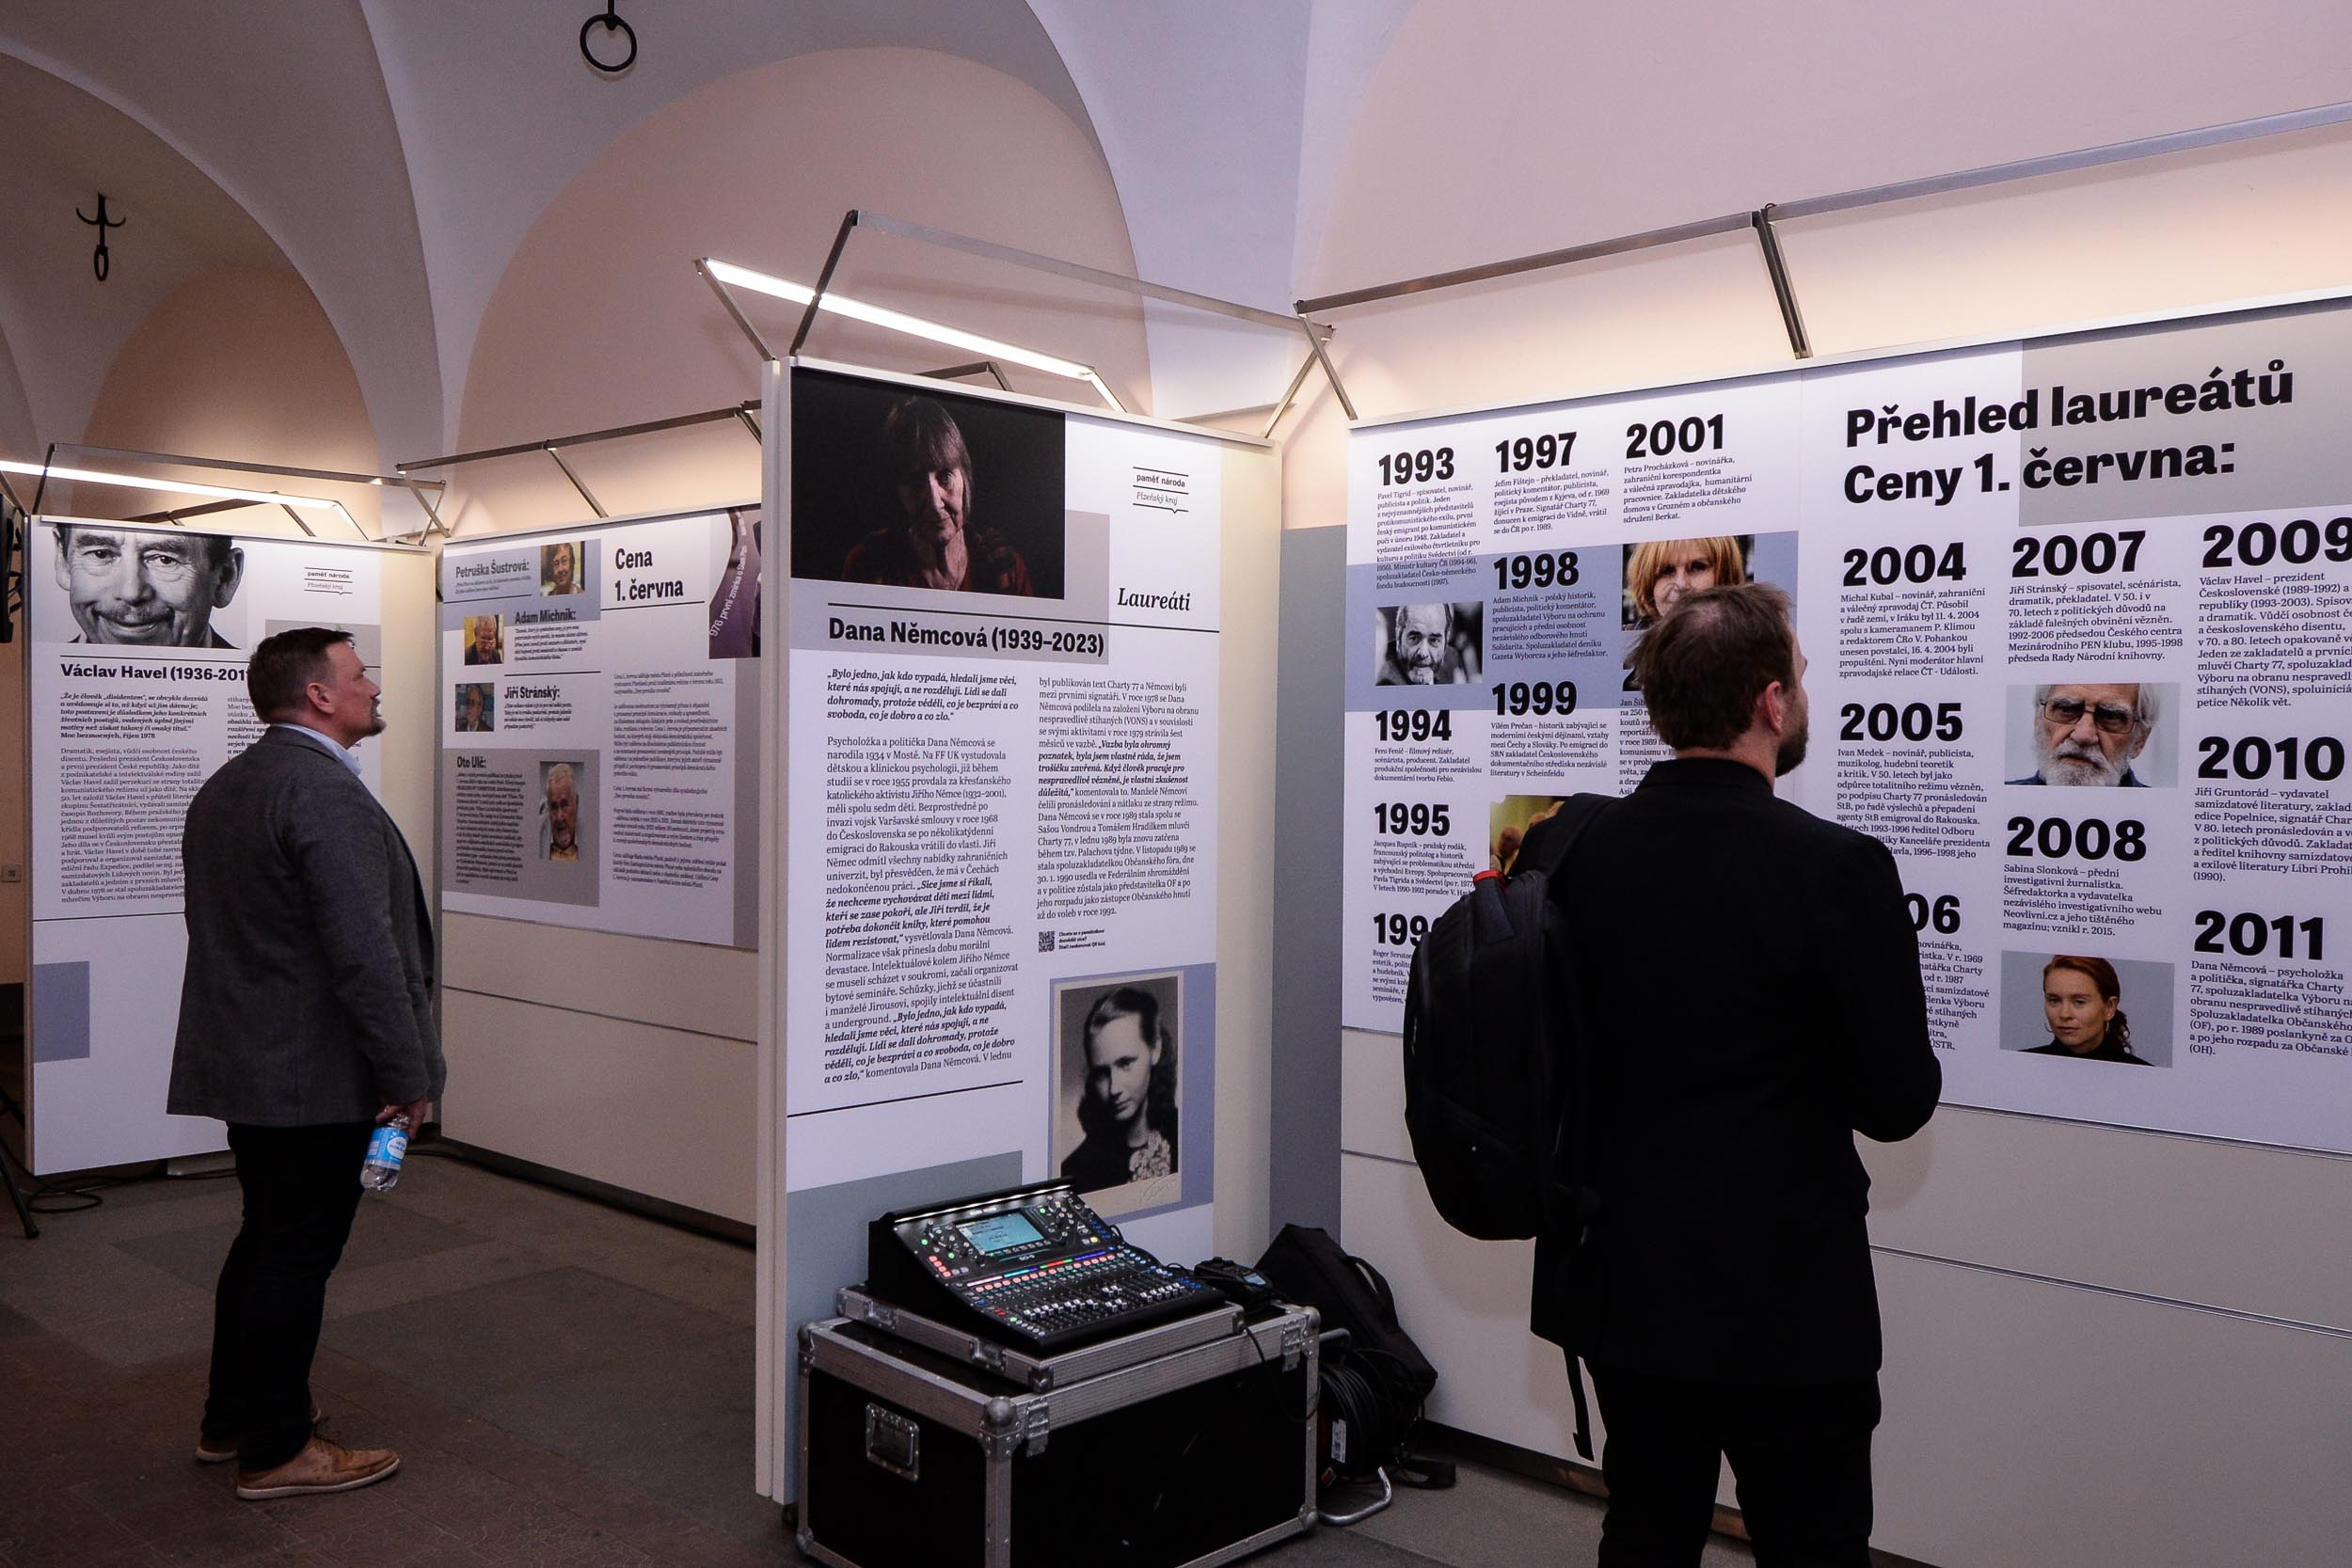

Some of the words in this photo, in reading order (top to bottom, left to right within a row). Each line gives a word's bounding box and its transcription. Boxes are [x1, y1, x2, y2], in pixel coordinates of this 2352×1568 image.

[1847, 388, 2039, 448] Přehled
[2051, 359, 2294, 427] laureátů
[1627, 414, 1723, 459] 2001
[1496, 432, 1576, 472] 1997
[1379, 448, 1454, 485] 1993
[1624, 473, 1661, 484] zahraniční
[1662, 467, 1722, 480] korespondentka
[1844, 465, 1963, 505] Ceny
[1974, 452, 2010, 493] 1.
[2023, 442, 2235, 489] června:
[1136, 474, 1159, 483] paměť
[1161, 476, 1185, 487] národa
[1136, 491, 1164, 504] Plzeňský
[1165, 496, 1178, 506] kraj
[1624, 494, 1663, 505] pracovnice.
[1664, 489, 1711, 499] Zakladatelka
[1712, 485, 1746, 496] dětského
[2202, 517, 2352, 567] 2009
[615, 548, 653, 570] Cena
[2012, 531, 2145, 578] 2007
[455, 563, 489, 578] Petruška
[490, 559, 530, 575] Šustrová:
[1494, 552, 1579, 590] 1998
[1843, 543, 1966, 586] 2004
[615, 580, 626, 601] 1.
[629, 580, 684, 600] června
[1118, 587, 1191, 611] Laureáti
[2199, 586, 2280, 598] Československé
[2282, 583, 2341, 595] (1989-1992)
[515, 611, 538, 625] Adam
[539, 608, 576, 623] Michnik:
[2009, 619, 2043, 628] základě
[2045, 617, 2089, 628] falešných
[2090, 615, 2133, 626] obvinění
[2135, 615, 2172, 625] vězněn.
[829, 618, 885, 642] Dana
[891, 621, 988, 647] Němcová
[2056, 628, 2106, 641] předsedou
[2107, 626, 2149, 637] Českého
[2150, 627, 2182, 636] centra
[2206, 623, 2299, 634] československého
[2301, 622, 2345, 631] disentu,
[2009, 641, 2079, 651] Mezinárodního
[2081, 641, 2101, 649] PEN
[2103, 640, 2134, 649] klubu,
[1839, 657, 1886, 669] propuštění.
[1888, 657, 1908, 667] Nyní
[1910, 656, 1955, 665] moderátor
[1956, 655, 1983, 664] hlavní
[2008, 653, 2050, 664] předseda
[2052, 653, 2075, 663] Rady
[2076, 651, 2116, 661] Národní
[2118, 651, 2165, 661] knihovny.
[60, 663, 117, 677] Václav
[121, 665, 167, 679] Havel
[170, 665, 249, 683] (1936-201
[852, 668, 879, 681] jedno,
[880, 670, 895, 681] jak
[897, 671, 913, 681] kdo
[914, 673, 948, 683] vypadá,
[949, 672, 978, 683] hledali
[977, 673, 997, 685] jsme
[999, 675, 1016, 686] věci,
[504, 686, 518, 699] Jiří
[519, 685, 560, 701] Stránský:
[1492, 681, 1577, 715] 1999
[2197, 698, 2228, 708] petice
[2230, 697, 2270, 706] Několik
[2272, 697, 2291, 706] vět.
[1375, 709, 1452, 741] 1994
[1840, 703, 1963, 741] 2005
[827, 736, 881, 748] Psycholožka
[889, 736, 926, 749] politička
[927, 737, 948, 747] Dana
[950, 737, 986, 747] Němcová
[457, 756, 470, 768] Oto
[471, 756, 486, 768] Ulč:
[1837, 759, 1883, 769] muzikolog,
[1883, 759, 1918, 768] hudební
[1920, 760, 1954, 768] teoretik
[2199, 736, 2344, 781] 2010
[1837, 780, 1871, 790] odpůrce
[1872, 781, 1916, 789] totalitního
[1918, 782, 1948, 790] režimu
[1949, 783, 1984, 792] vězněn,
[1375, 803, 1450, 836] 1995
[2007, 816, 2146, 862] 2008
[2004, 876, 2065, 887] investigativní
[2066, 879, 2123, 890] žurnalistka.
[2193, 871, 2226, 882] (1990).
[2003, 887, 2069, 898] Šéfredaktorka
[2077, 891, 2133, 902] vydavatelka
[1037, 911, 1045, 920] až
[1046, 910, 1057, 919] do
[1057, 909, 1076, 918] voleb
[1083, 909, 1099, 917] roce
[1100, 908, 1117, 917] 1992.
[1904, 892, 1962, 935] 06
[2003, 898, 2057, 909] nezávislého
[2058, 901, 2134, 913] investigativního
[2136, 906, 2162, 915] webu
[1372, 912, 1443, 946] 199
[2003, 922, 2050, 932] magazínu;
[2051, 925, 2080, 933] vznikl
[2090, 927, 2116, 936] 2015.
[2195, 911, 2323, 960] 2011
[826, 950, 881, 962] Normalizace
[882, 946, 900, 958] však
[902, 944, 936, 958] přinesla
[937, 942, 958, 953] dobu
[959, 939, 990, 951] morální
[2199, 974, 2247, 986] politička,
[2249, 976, 2304, 990] signatářka
[2306, 981, 2344, 995] Charty
[2189, 1043, 2216, 1055] (OH).
